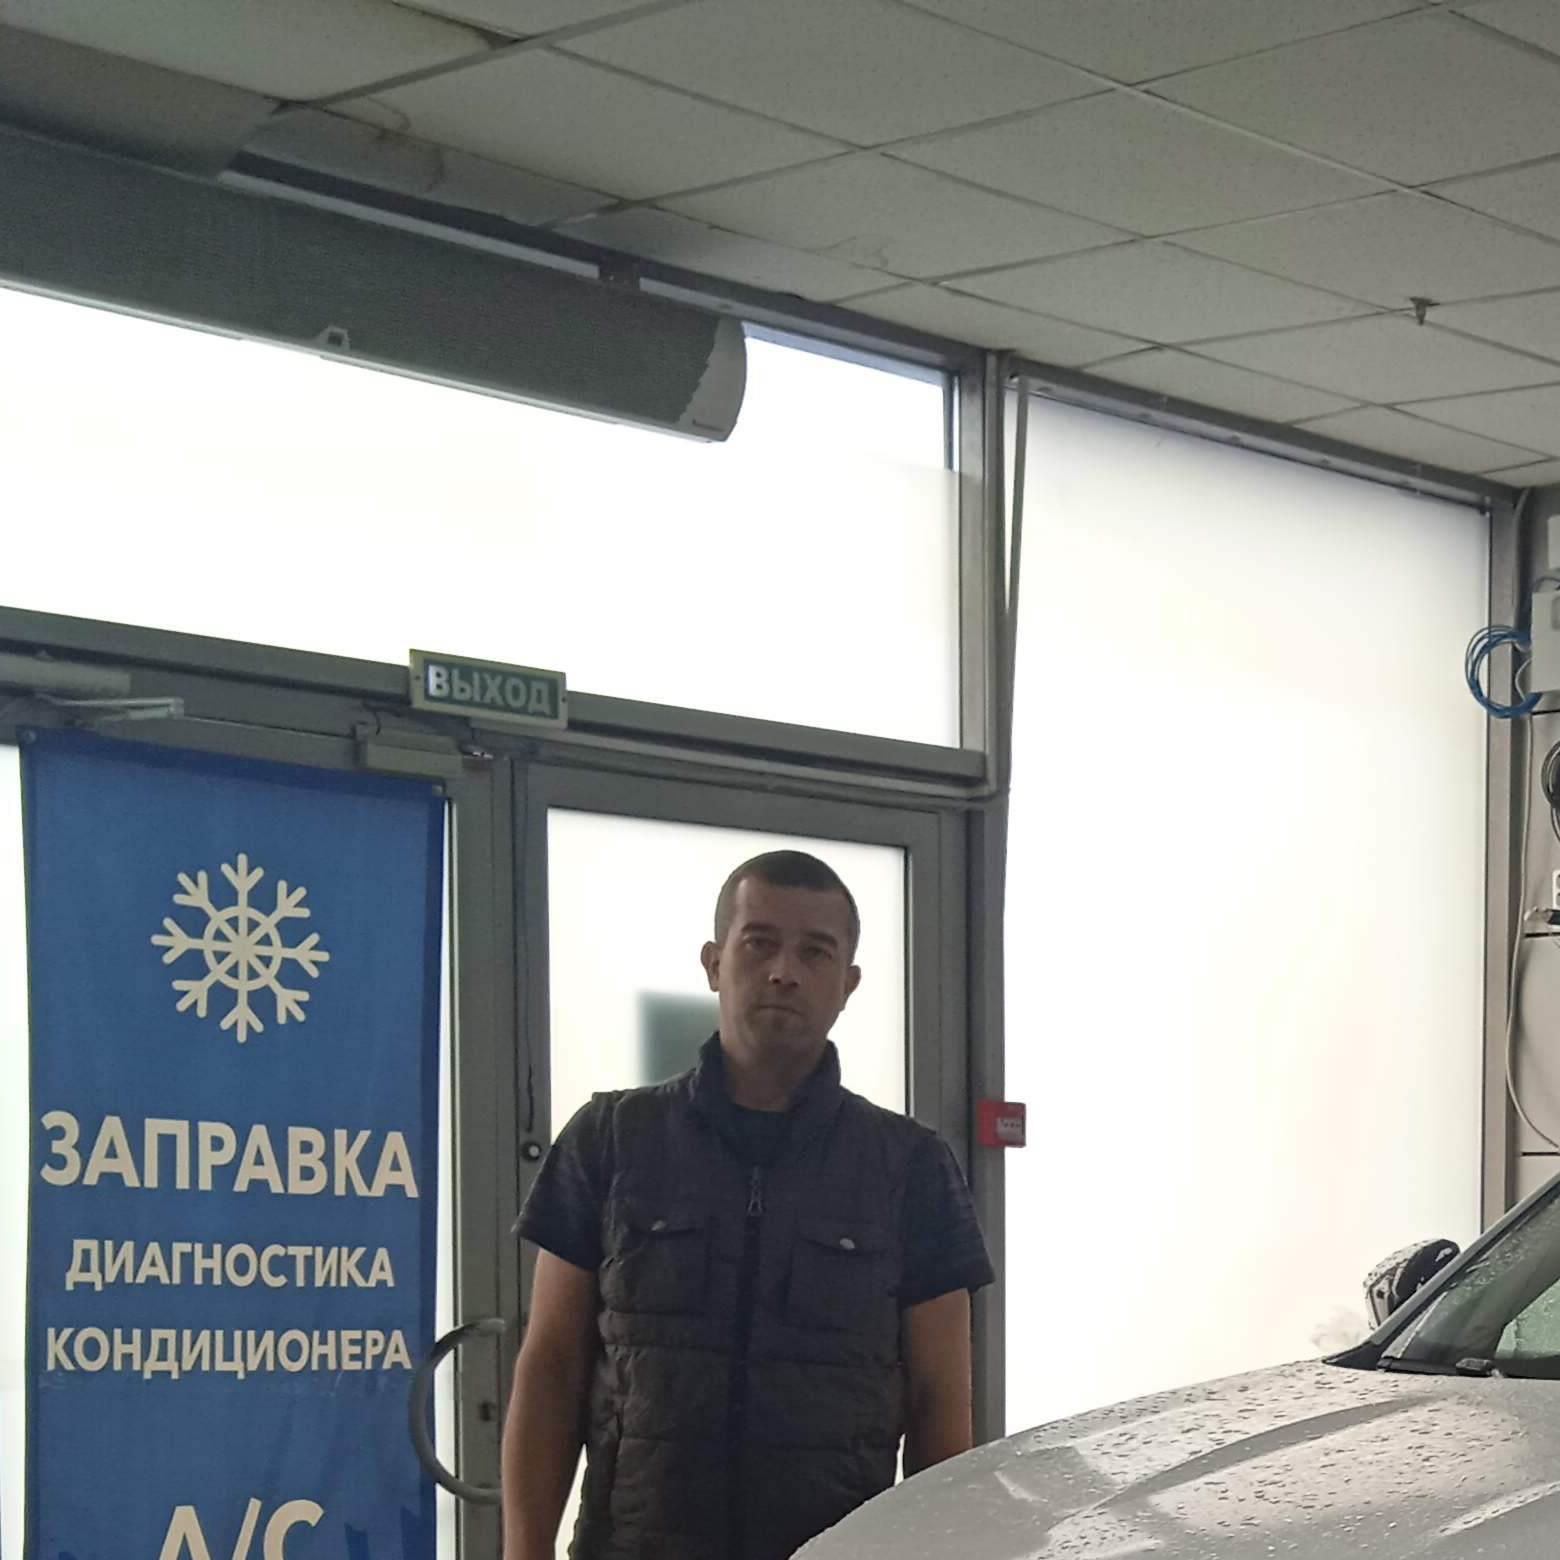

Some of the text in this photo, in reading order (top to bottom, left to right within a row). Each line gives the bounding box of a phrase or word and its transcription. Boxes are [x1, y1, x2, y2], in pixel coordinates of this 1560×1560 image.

[428, 664, 551, 714] ВЫХОД
[39, 1110, 419, 1199] ЗАПРАВКА
[65, 1239, 395, 1291] ДИАГНОСТИКА
[46, 1327, 412, 1380] КОНДИЦИОНЕРА
